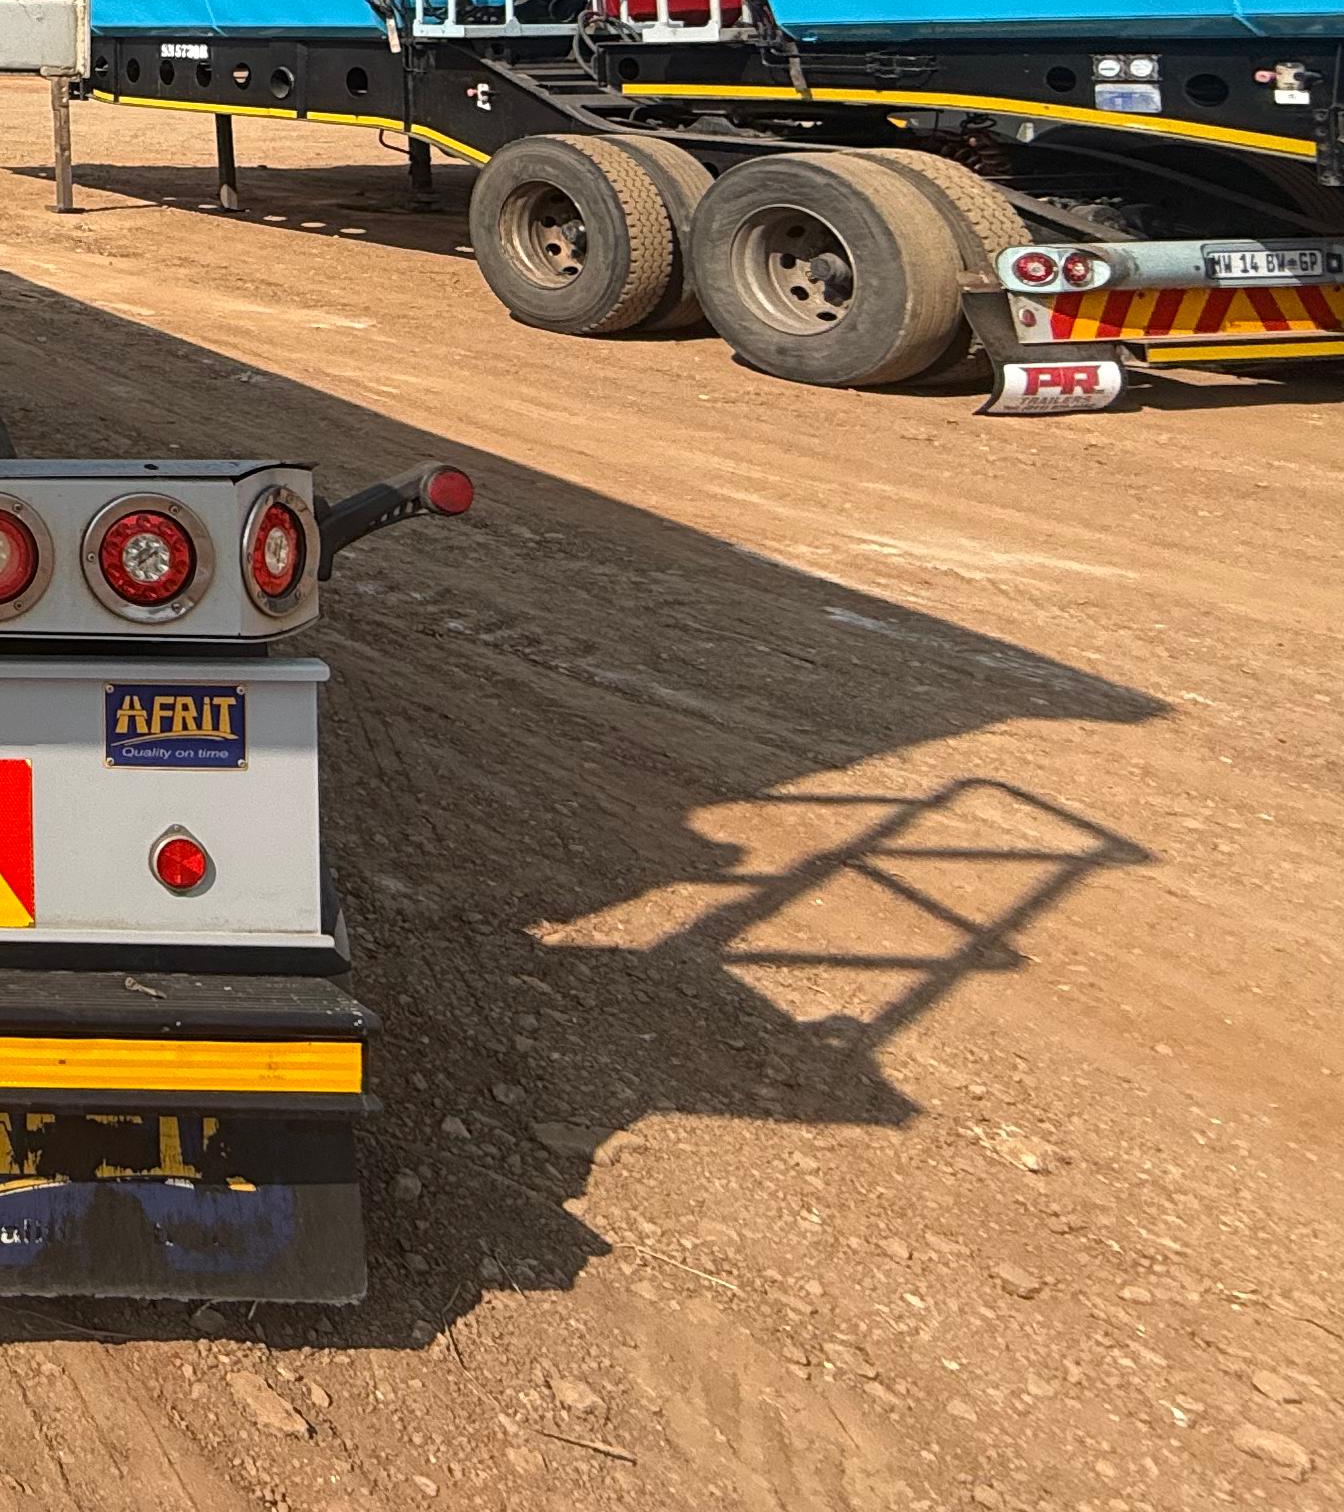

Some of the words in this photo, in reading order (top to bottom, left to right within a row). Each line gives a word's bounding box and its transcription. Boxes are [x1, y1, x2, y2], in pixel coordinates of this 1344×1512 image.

[1298, 251, 1317, 272] GP
[1020, 365, 1101, 396] PR
[122, 747, 172, 759] Quality
[175, 750, 194, 758] on
[198, 748, 229, 759] time
